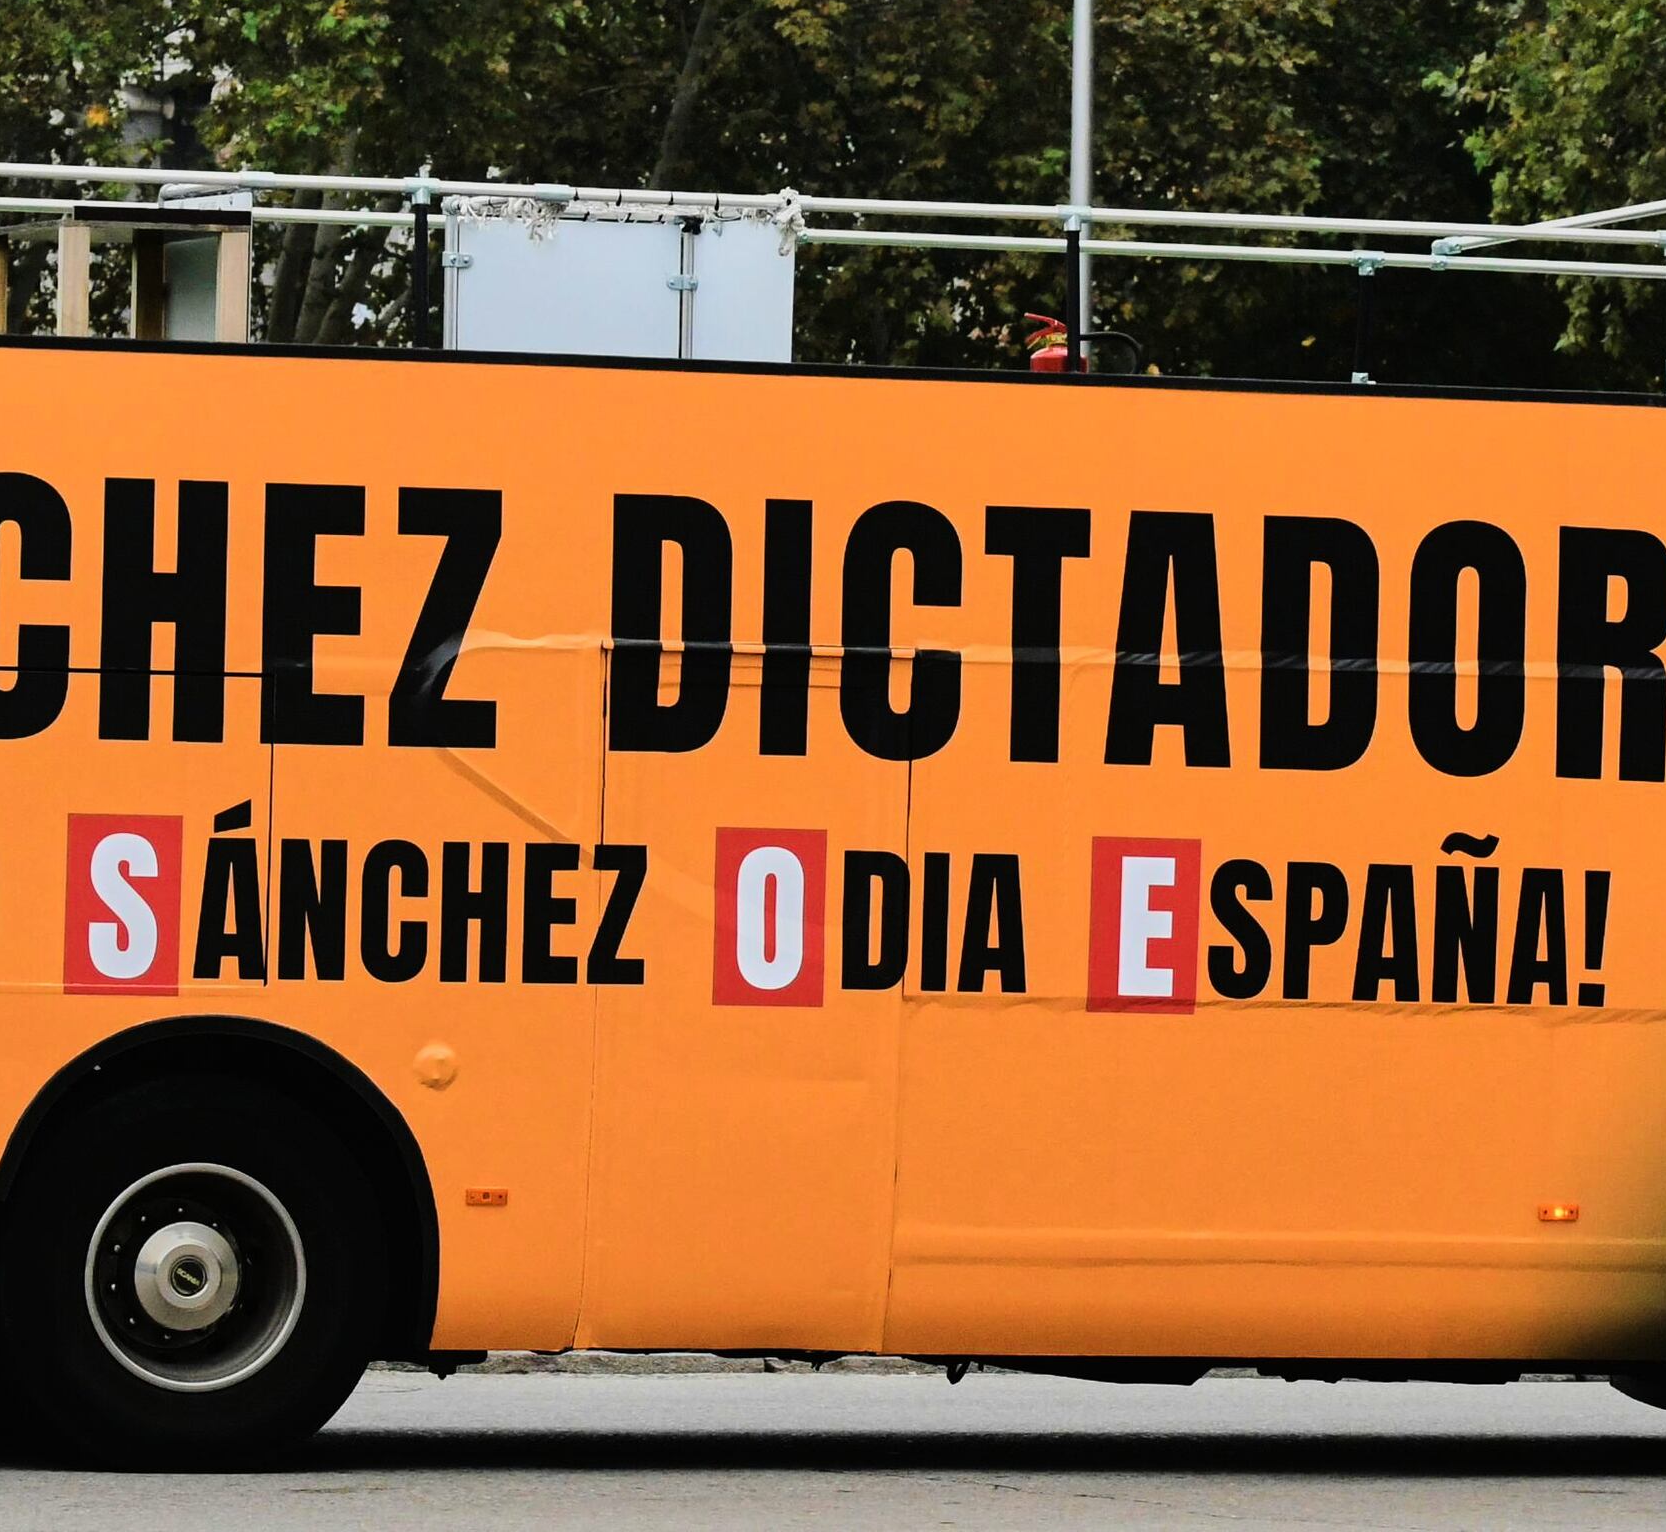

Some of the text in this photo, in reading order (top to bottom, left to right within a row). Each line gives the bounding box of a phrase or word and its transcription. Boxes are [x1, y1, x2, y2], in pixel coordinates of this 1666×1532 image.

[89, 800, 646, 984] SÁNCHEZ
[737, 847, 1026, 993] ODIA
[1118, 833, 1611, 1008] ESPAÑA!
